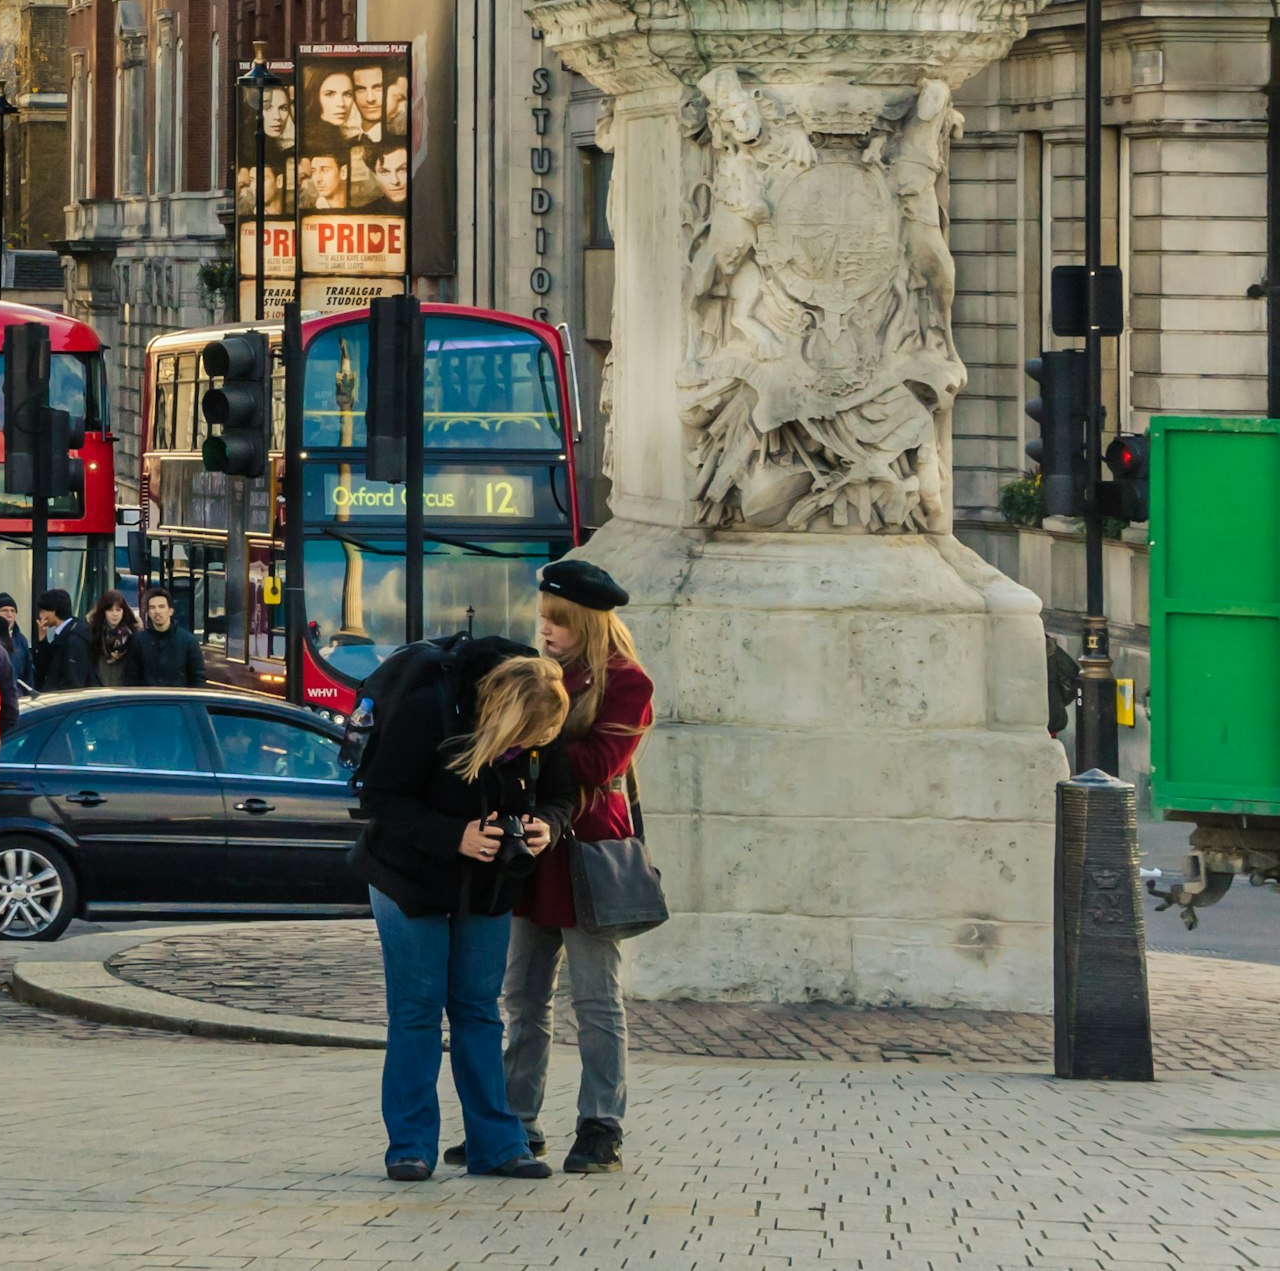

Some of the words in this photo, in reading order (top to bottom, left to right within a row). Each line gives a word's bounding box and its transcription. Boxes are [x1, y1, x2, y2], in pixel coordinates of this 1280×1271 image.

[300, 45, 312, 53] THE
[313, 45, 333, 53] MULTI
[333, 44, 390, 53] AWARD-WINNING
[391, 44, 408, 53] PLAY
[239, 62, 250, 70] THE
[306, 223, 317, 231] THE
[318, 223, 401, 254] PRIDE
[326, 286, 383, 296] TRAFALGAR
[326, 296, 368, 306] STUDIOS
[332, 486, 394, 507] Oxford
[485, 481, 515, 514] 12
